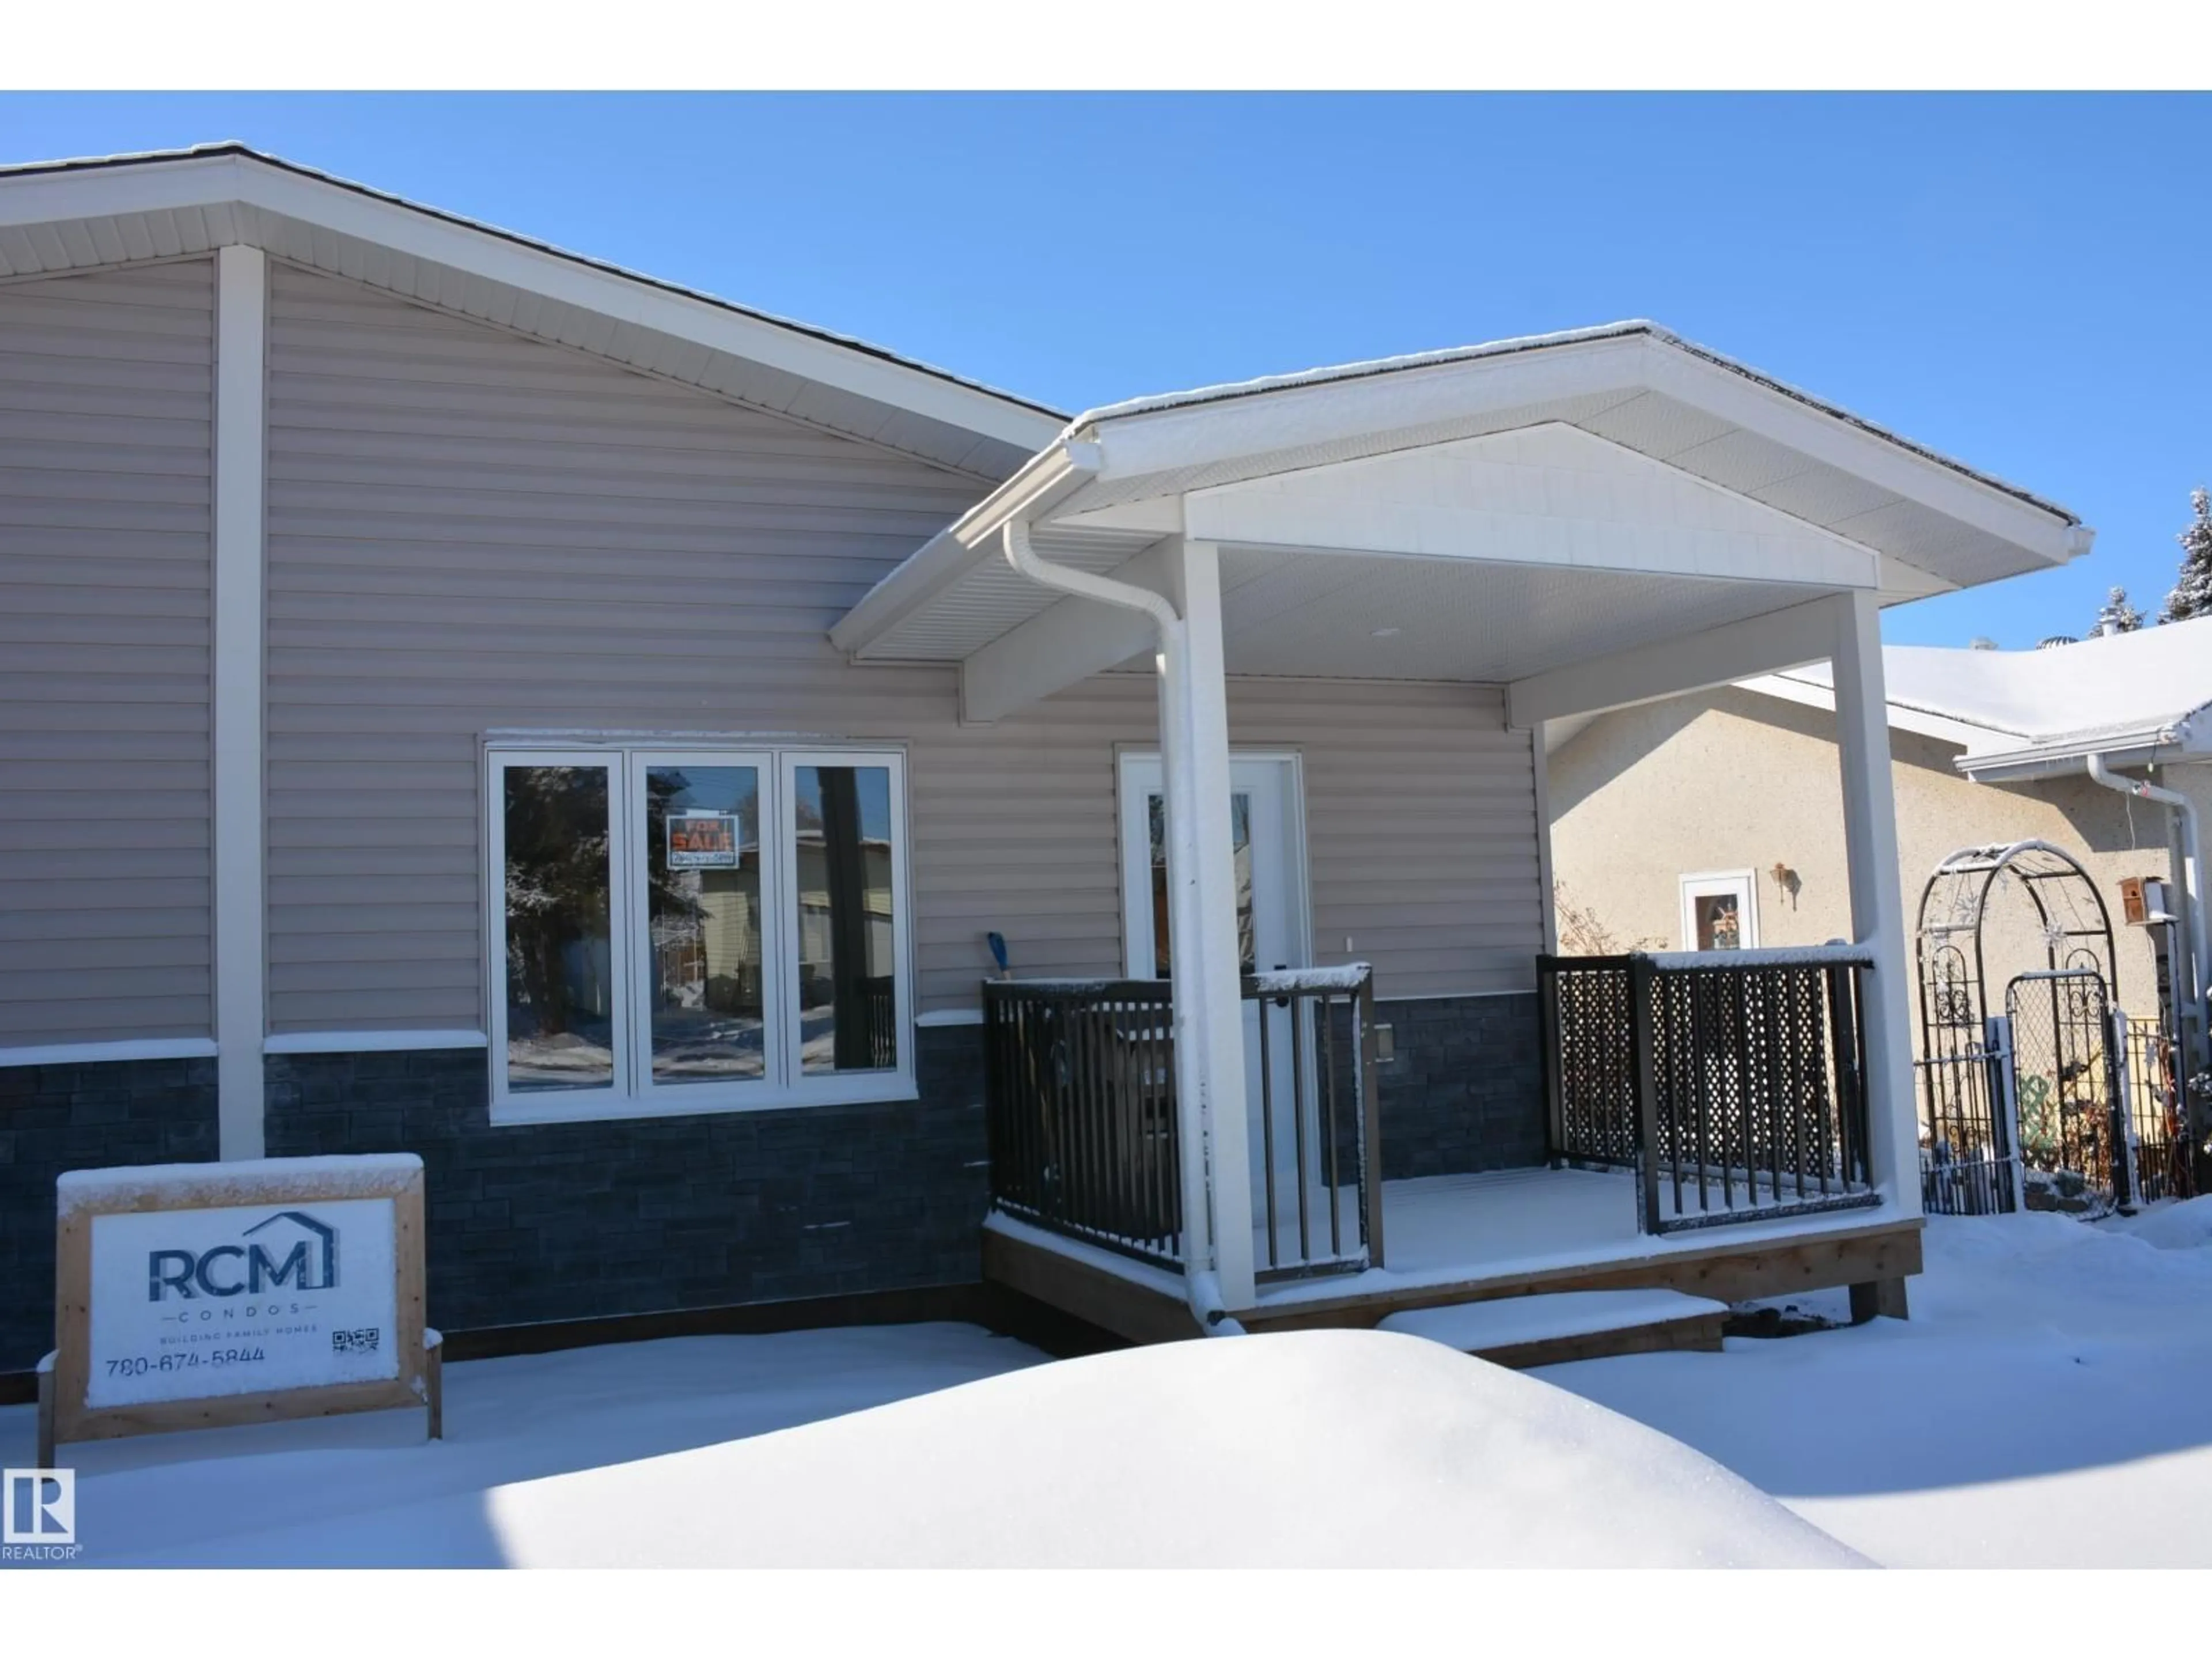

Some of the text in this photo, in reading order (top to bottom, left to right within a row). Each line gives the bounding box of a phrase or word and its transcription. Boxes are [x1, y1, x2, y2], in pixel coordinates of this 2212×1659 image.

[672, 832, 732, 851] SALE
[178, 1303, 300, 1323] CONDOS
[160, 1324, 317, 1344] BUILDING FAMILY HOMES
